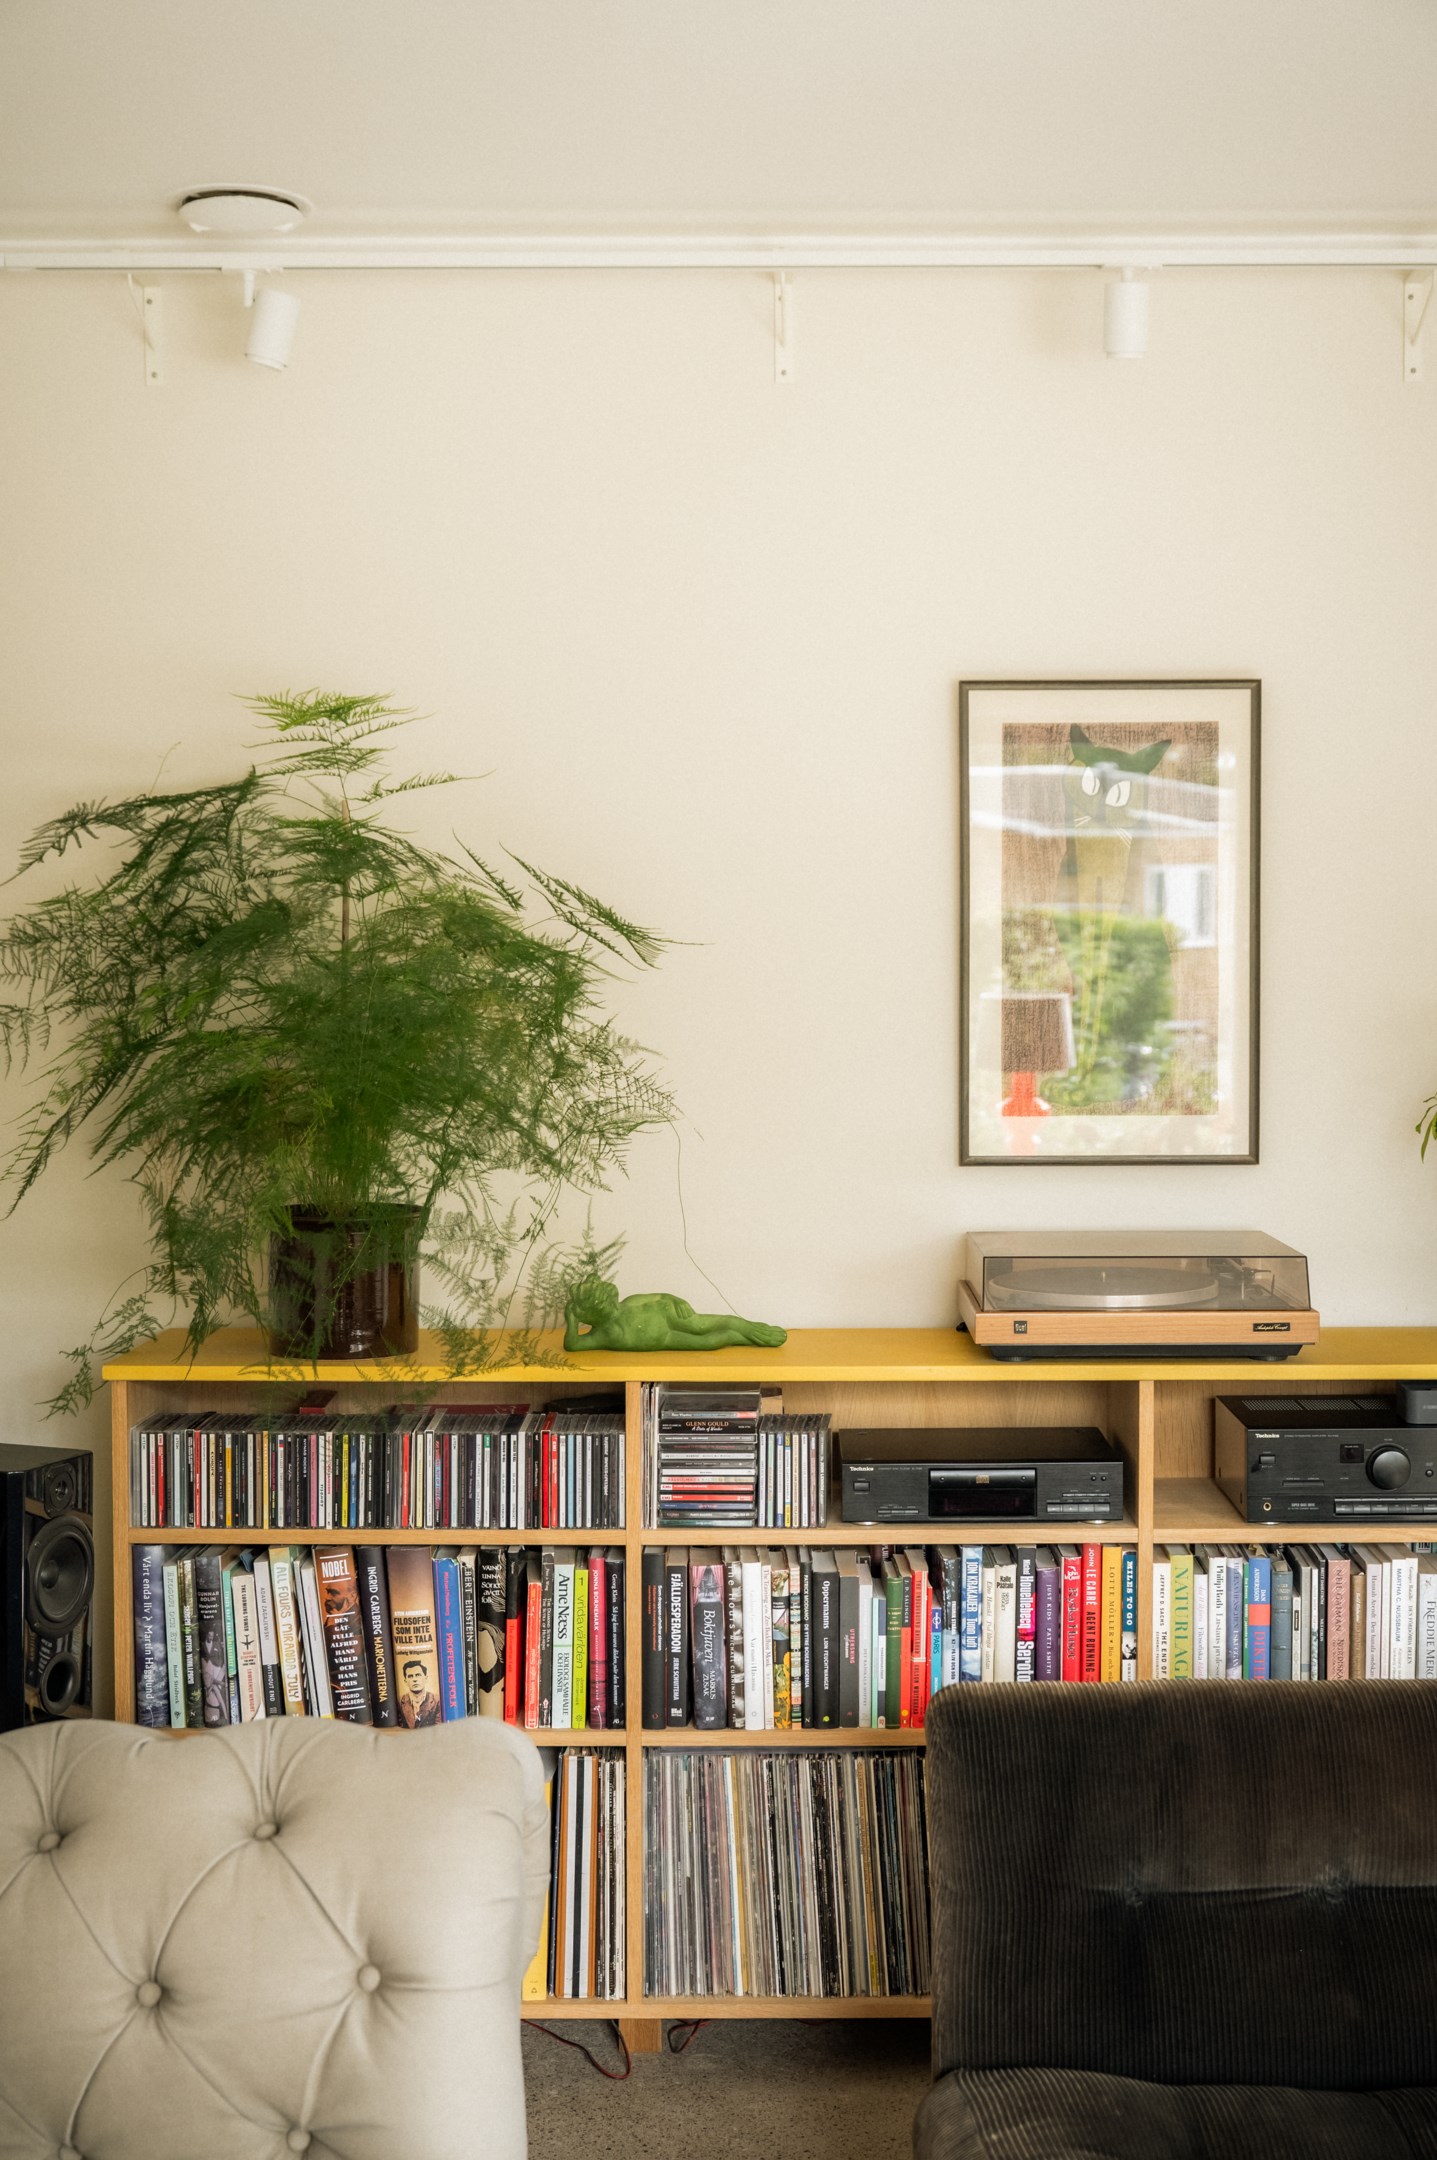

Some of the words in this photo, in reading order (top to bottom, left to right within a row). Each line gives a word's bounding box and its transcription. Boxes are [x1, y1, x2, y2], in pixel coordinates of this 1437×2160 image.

[142, 1556, 151, 1575] Vårt
[276, 1566, 287, 1584] ALL
[321, 1559, 350, 1578] NOBEL
[966, 1561, 978, 1575] JON
[1022, 1559, 1031, 1576] Michel
[1086, 1569, 1095, 1579] LE
[1213, 1565, 1225, 1588] Philip
[143, 1578, 151, 1600] enda
[367, 1566, 378, 1593] INGRID
[558, 1573, 570, 1604] Arne
[277, 1586, 291, 1618] FOURS
[762, 1581, 771, 1604] Training
[821, 1580, 831, 1629] Oppermanns
[967, 1575, 978, 1612] KRAKAUER
[1017, 1575, 1035, 1629] Houellebecq
[1086, 1580, 1098, 1606] CARRÉ
[1126, 1596, 1133, 1610] TO
[1215, 1589, 1224, 1609] Roth
[1395, 1594, 1402, 1604] C.
[144, 1602, 152, 1613] liv
[369, 1595, 382, 1635] CARLBERG
[576, 1594, 585, 1625] vrida
[671, 1573, 682, 1653] FJÄLLDESPERADON
[728, 1593, 736, 1630] Hours
[1108, 1600, 1116, 1637] MÖLLER
[1126, 1612, 1133, 1626] GO
[1334, 1592, 1343, 1632] GAIMAN
[394, 1616, 431, 1626] FILOSOFEN
[395, 1626, 411, 1634] SOM
[413, 1625, 430, 1634] INTE
[465, 1599, 473, 1642] EINSTEIN
[557, 1605, 570, 1639] Næss
[967, 1618, 977, 1635] Tunn
[1086, 1611, 1096, 1635] AGENT
[1215, 1613, 1224, 1645] Lustans
[1422, 1601, 1436, 1647] FREDDIE
[144, 1625, 153, 1655] Martin
[282, 1623, 296, 1671] MIRANDA
[330, 1640, 358, 1649] ALFRED
[394, 1635, 413, 1644] VILLE
[414, 1634, 433, 1643] TALA
[575, 1626, 585, 1669] världen
[700, 1609, 716, 1663] Boktjuven
[932, 1634, 940, 1654] PARIS
[966, 1636, 978, 1648] luft
[334, 1655, 358, 1663] VÄRLD
[1085, 1638, 1096, 1673] RUNNING
[143, 1657, 155, 1699] Hägglund
[266, 1664, 275, 1689] WITHOUT
[338, 1672, 358, 1680] HANS
[374, 1636, 388, 1702] MARIONETTERNA
[1161, 1665, 1167, 1675] OF
[286, 1674, 300, 1699] JULY
[702, 1673, 710, 1697] ZUSAK
[337, 1698, 365, 1706] CARLBERG
